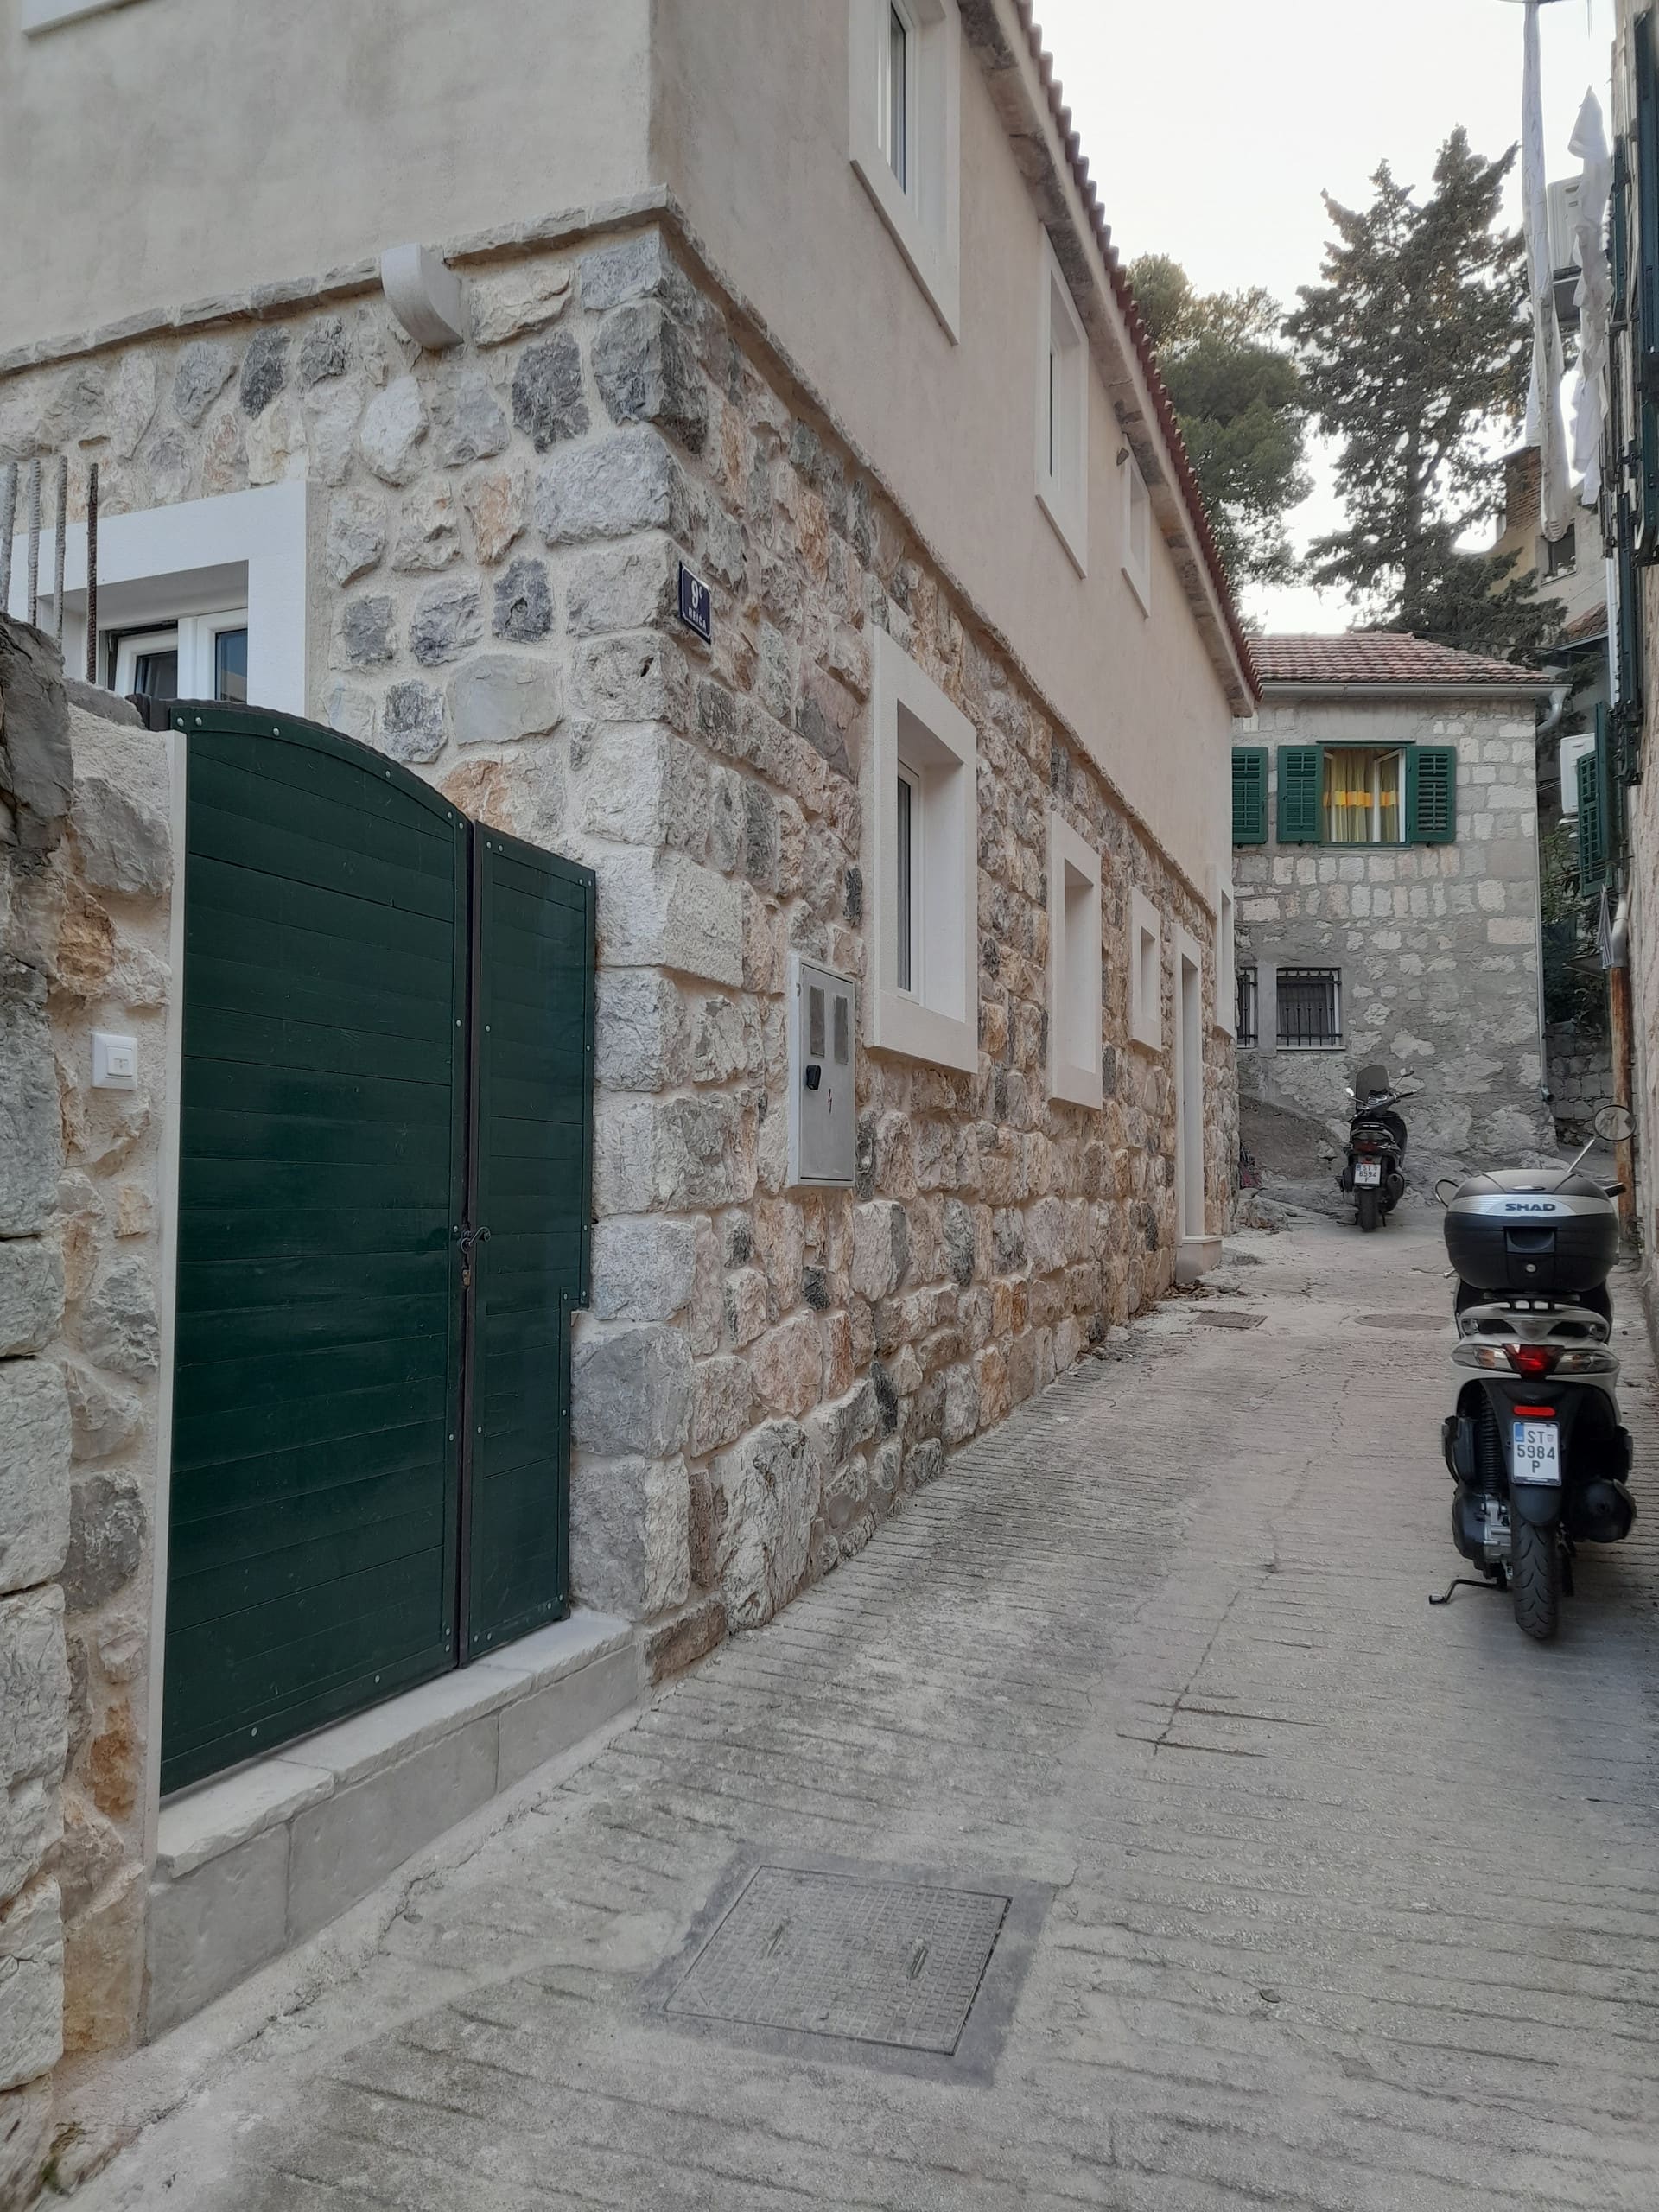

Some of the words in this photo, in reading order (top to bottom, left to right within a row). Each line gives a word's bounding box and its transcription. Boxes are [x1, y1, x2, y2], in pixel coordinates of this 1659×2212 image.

[1505, 1203, 1555, 1211] SHAD
[1527, 1430, 1546, 1444] ST
[1516, 1444, 1556, 1460] 5984
[1532, 1460, 1541, 1473] P
